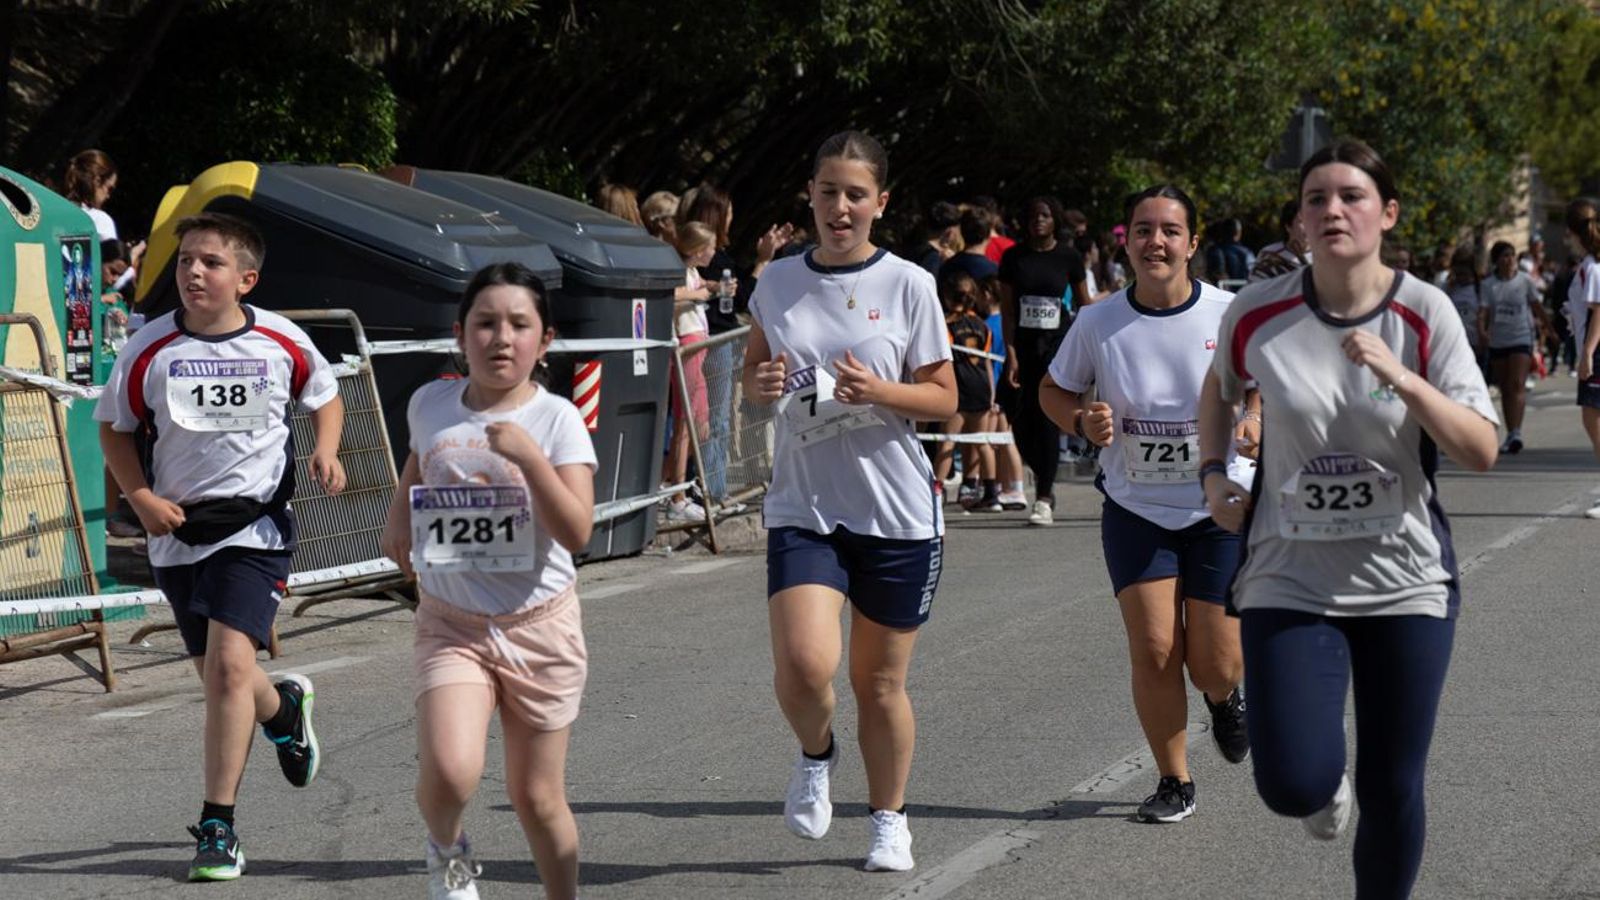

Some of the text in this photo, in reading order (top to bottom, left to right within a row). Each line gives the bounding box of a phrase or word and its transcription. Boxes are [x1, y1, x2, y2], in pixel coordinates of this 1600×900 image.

[191, 384, 247, 407] 138
[1140, 442, 1190, 462] 721
[1304, 482, 1374, 511] 323
[429, 515, 514, 544] 1281
